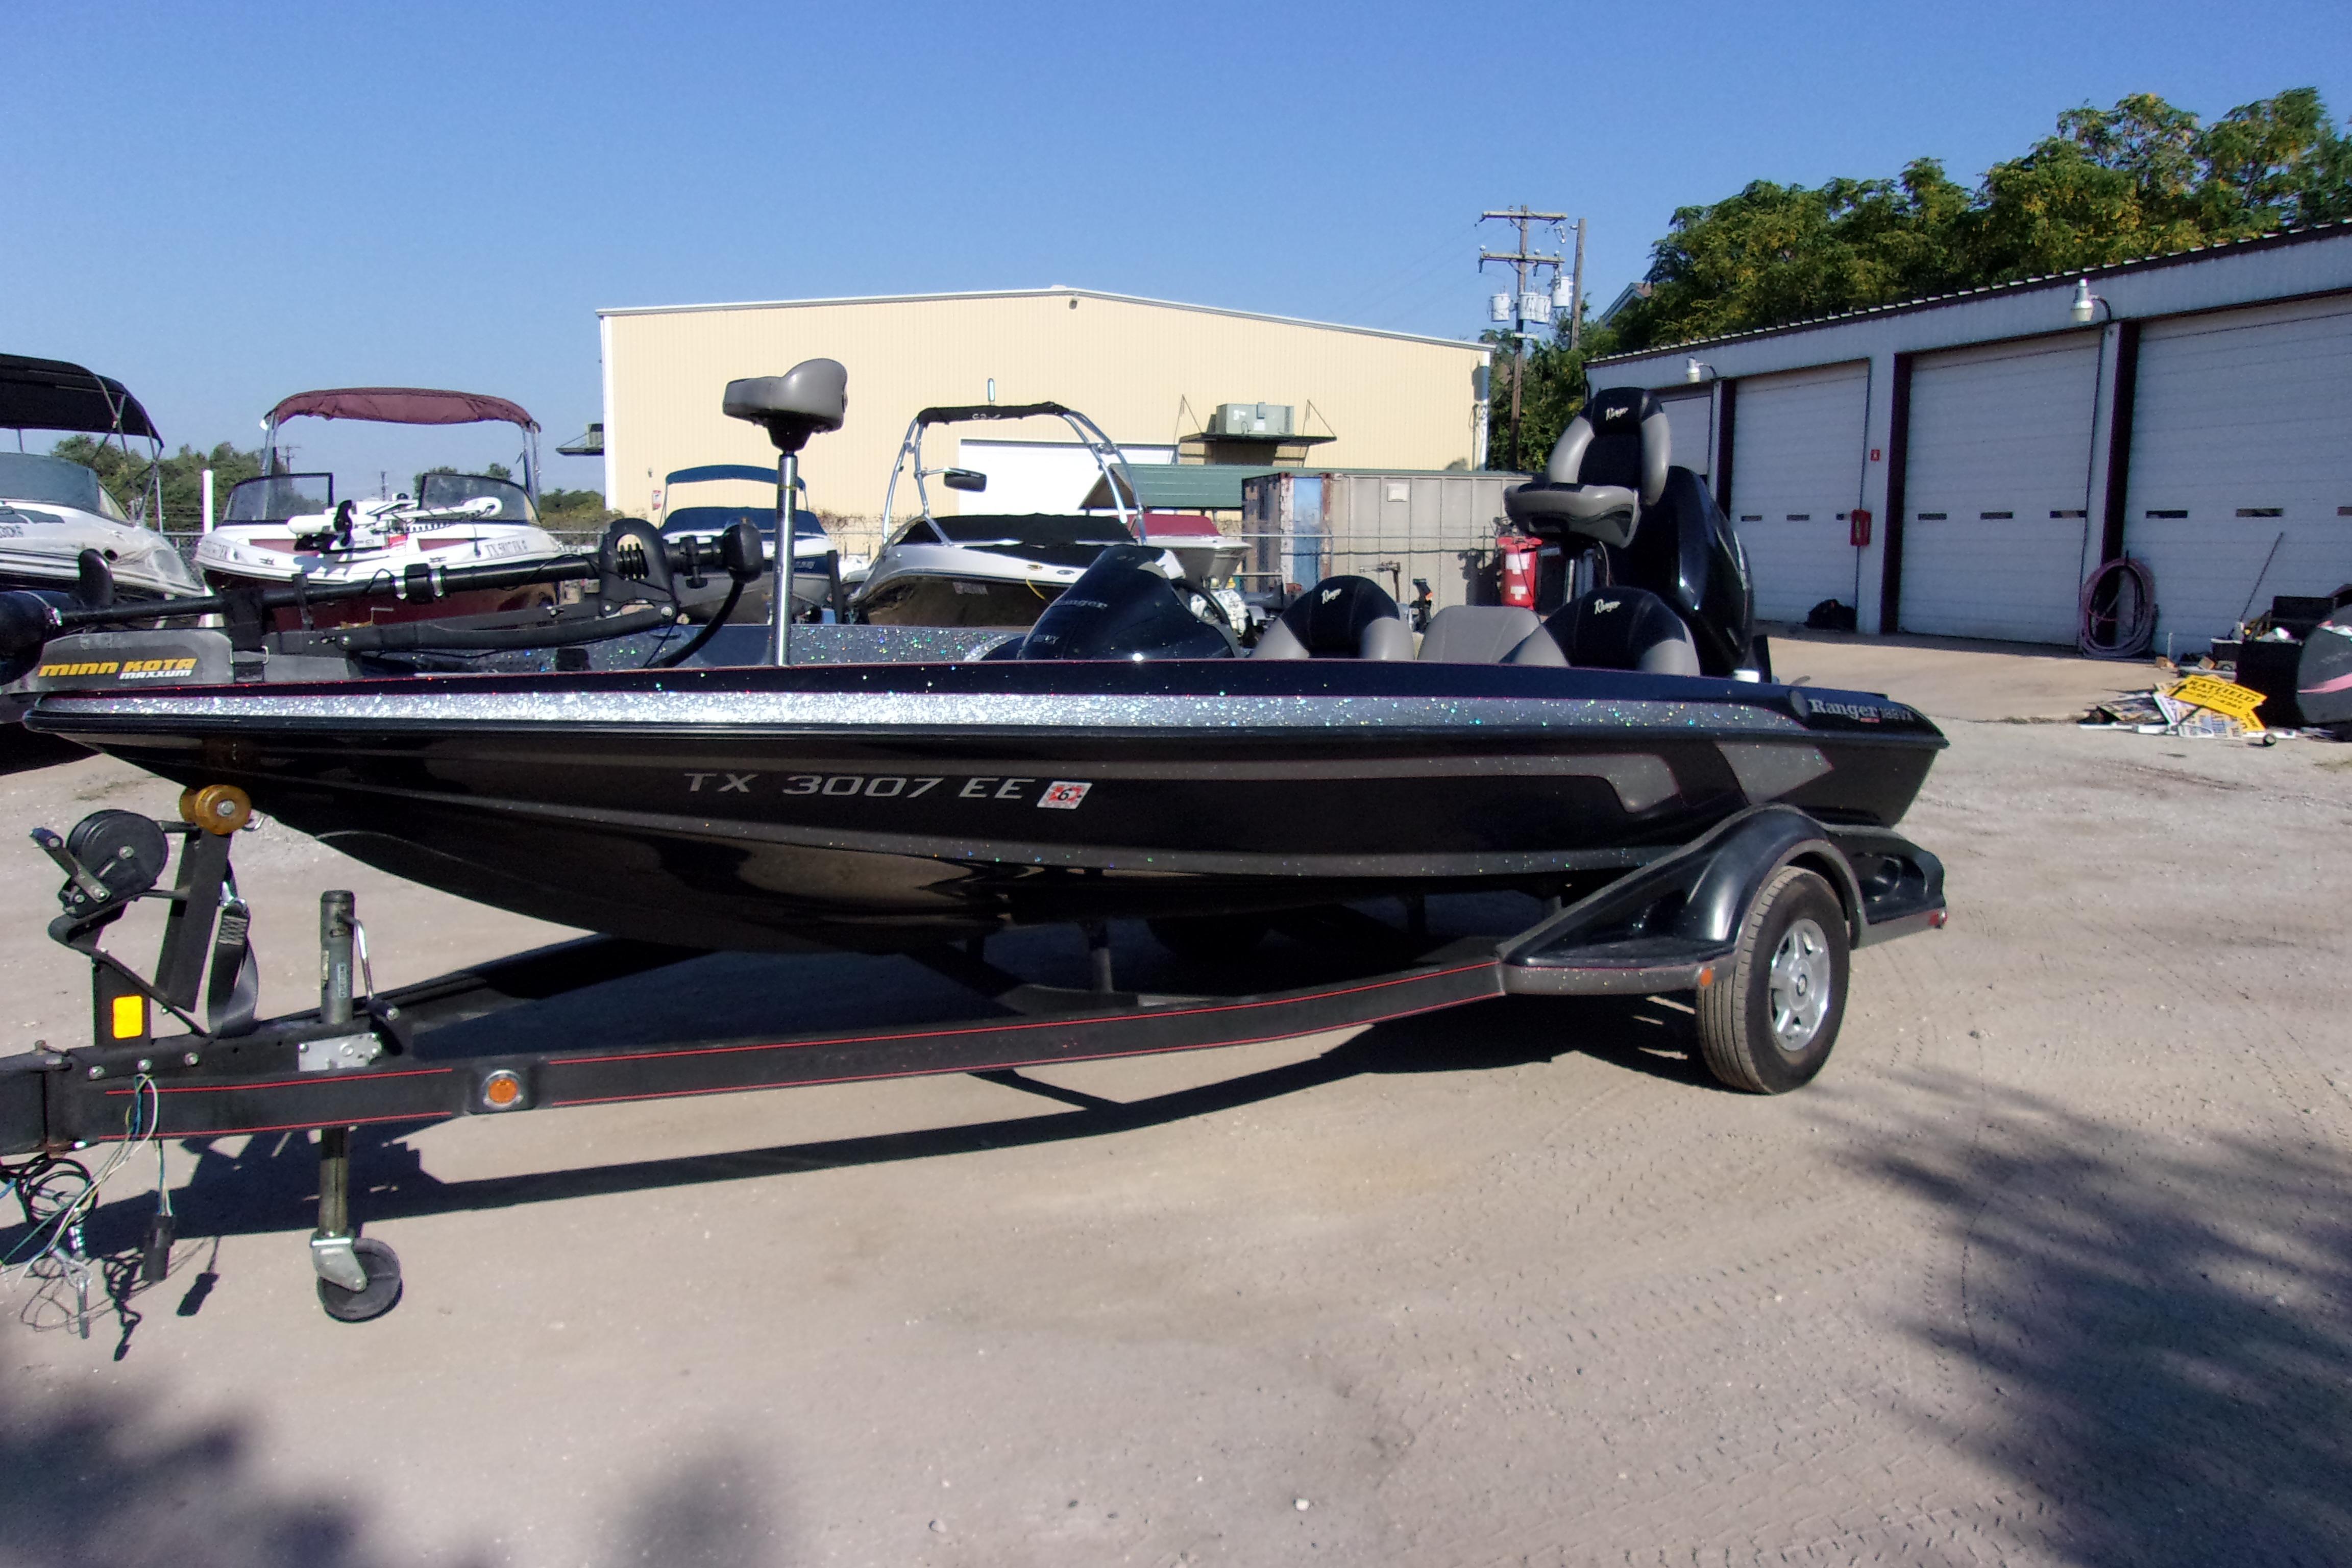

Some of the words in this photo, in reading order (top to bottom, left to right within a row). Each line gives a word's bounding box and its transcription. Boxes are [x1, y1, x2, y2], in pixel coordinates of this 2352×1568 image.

[121, 658, 198, 672] KOTA
[118, 669, 192, 680] MAXXUM
[1808, 698, 1878, 720] Ranger
[684, 773, 759, 793] TX
[782, 775, 944, 798] 3007
[958, 777, 1036, 799] EE
